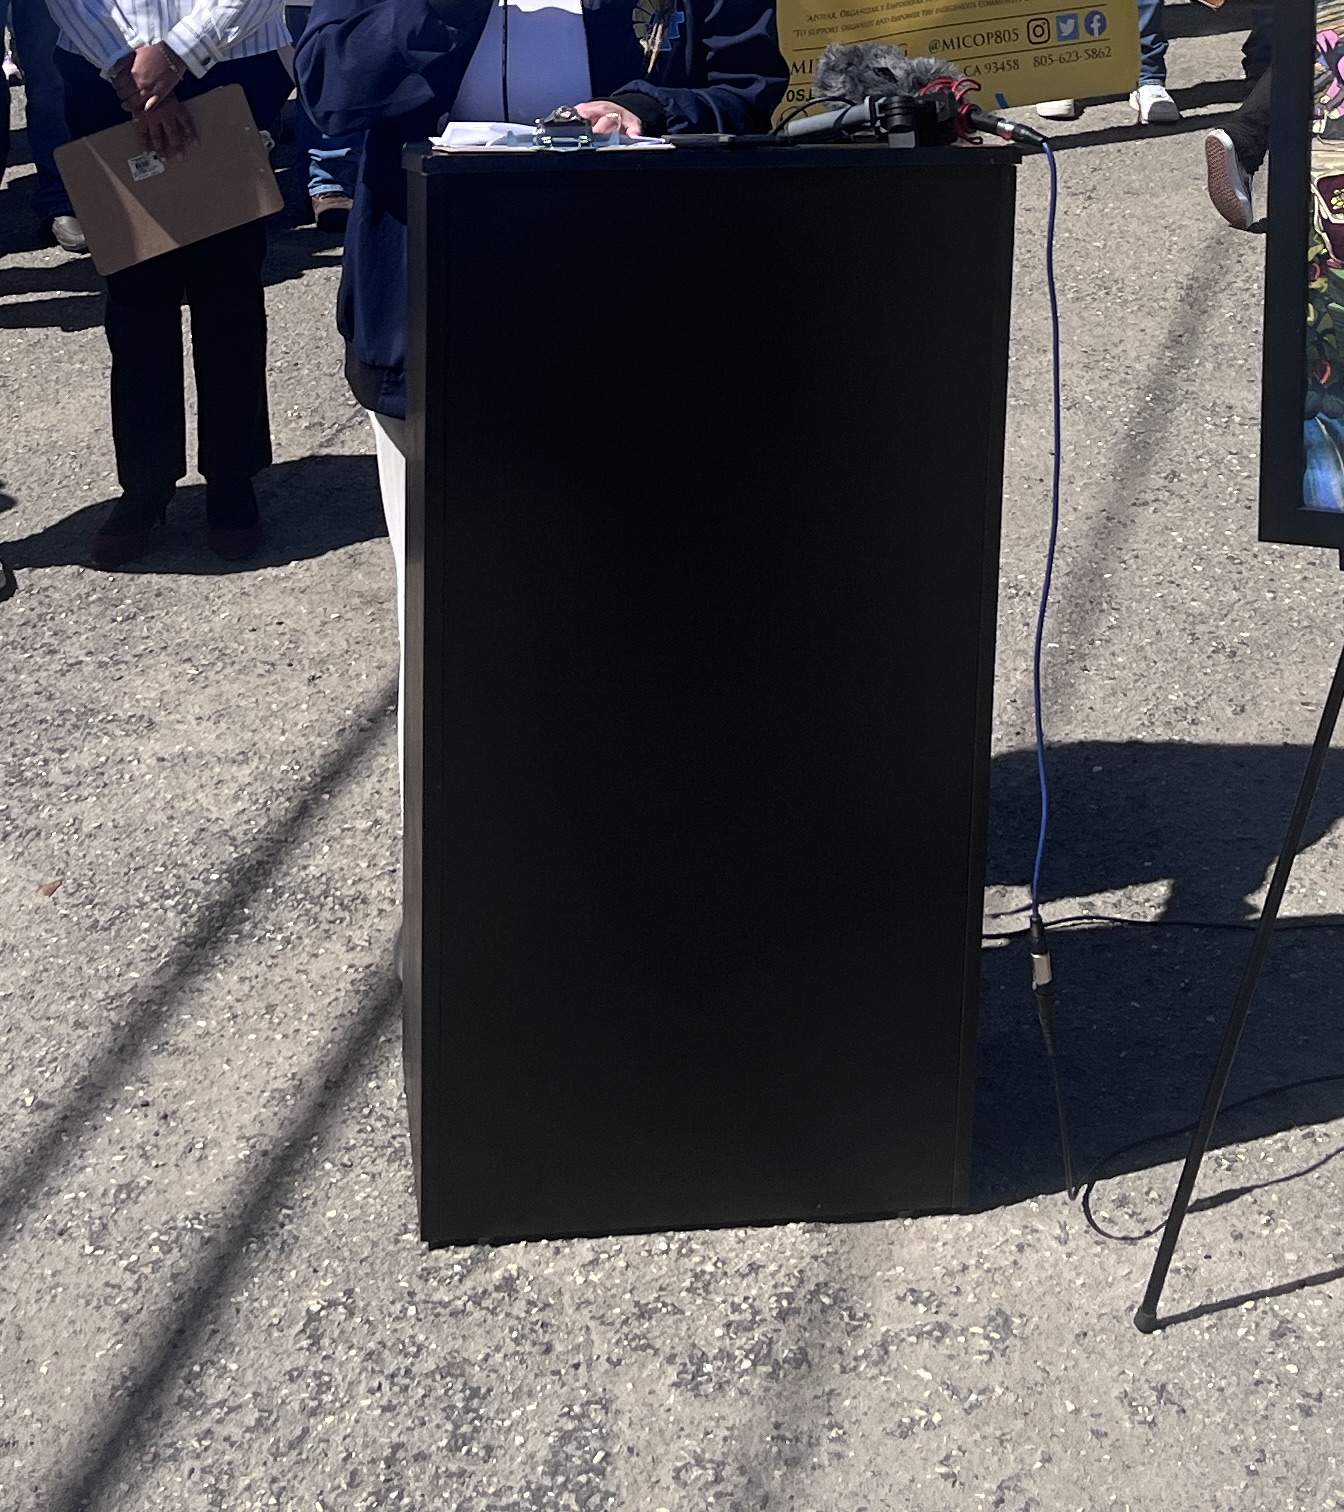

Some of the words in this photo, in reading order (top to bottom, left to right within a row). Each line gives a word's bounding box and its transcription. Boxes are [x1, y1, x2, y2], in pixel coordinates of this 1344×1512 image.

[928, 27, 1020, 54] @MICOP805
[963, 65, 982, 78] CA
[984, 59, 1020, 74] 93458
[1033, 46, 1113, 68] 805-623-5862
